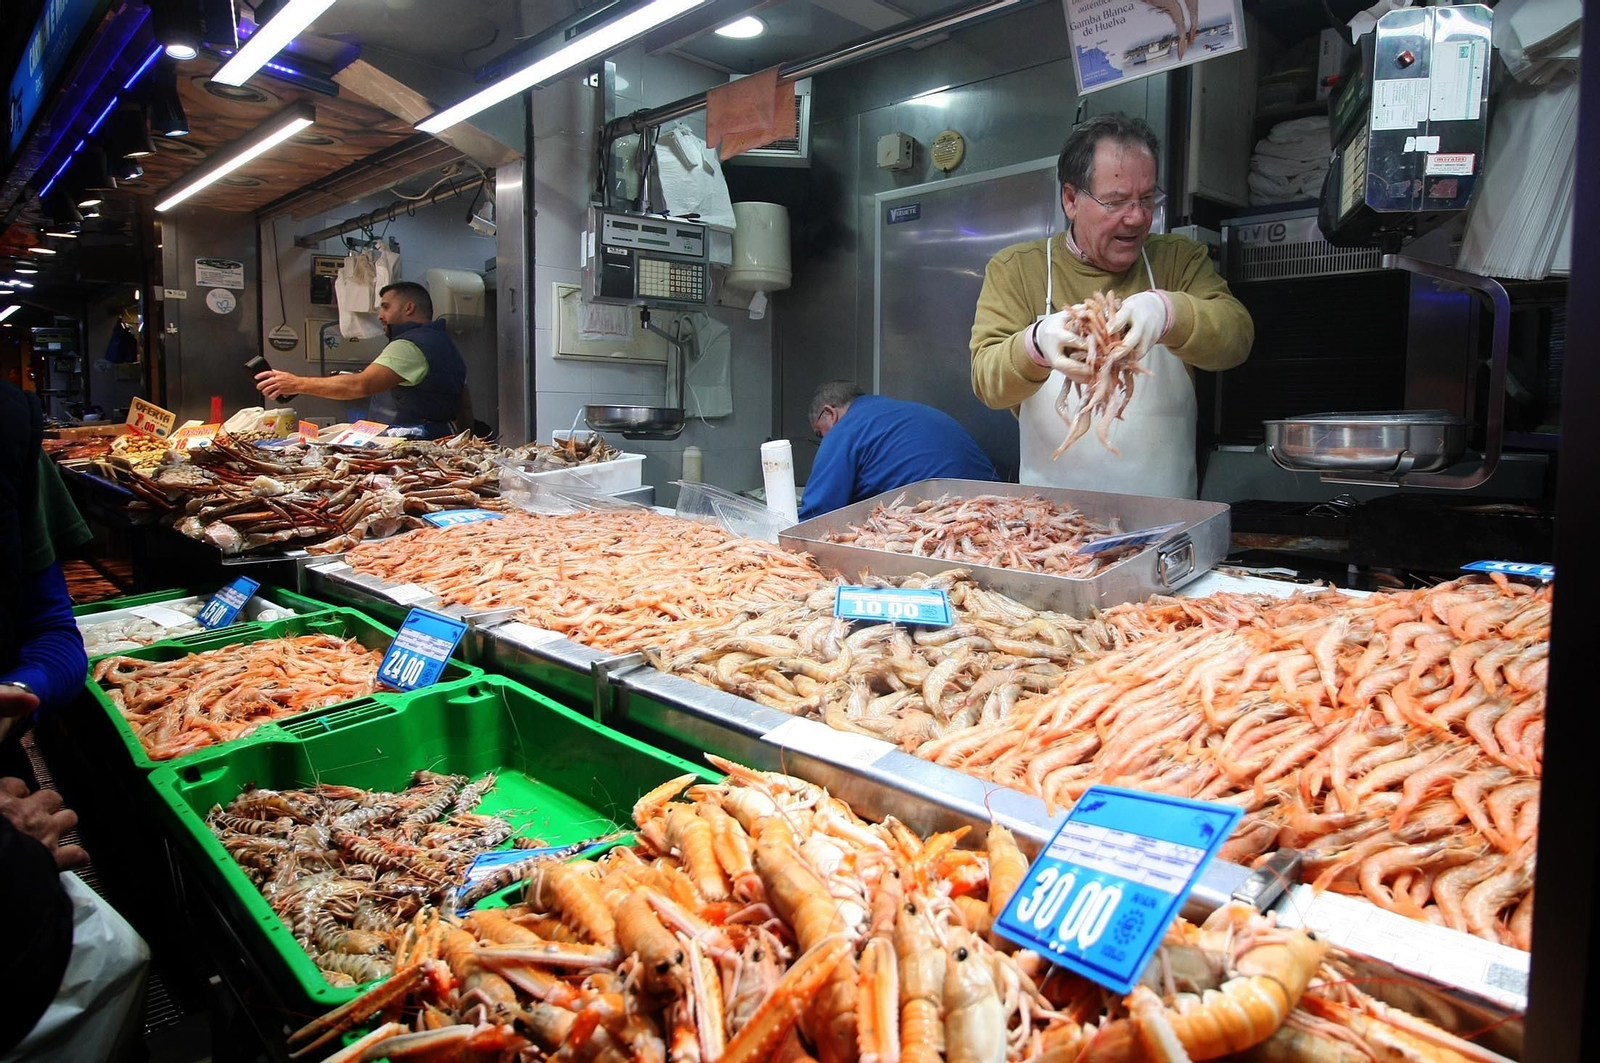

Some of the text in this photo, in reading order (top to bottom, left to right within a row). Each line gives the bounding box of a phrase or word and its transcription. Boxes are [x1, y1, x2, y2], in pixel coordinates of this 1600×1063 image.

[1070, 3, 1134, 30] Gamba Blanca
[1083, 17, 1126, 36] de Huelva
[136, 402, 171, 423] OFERTA
